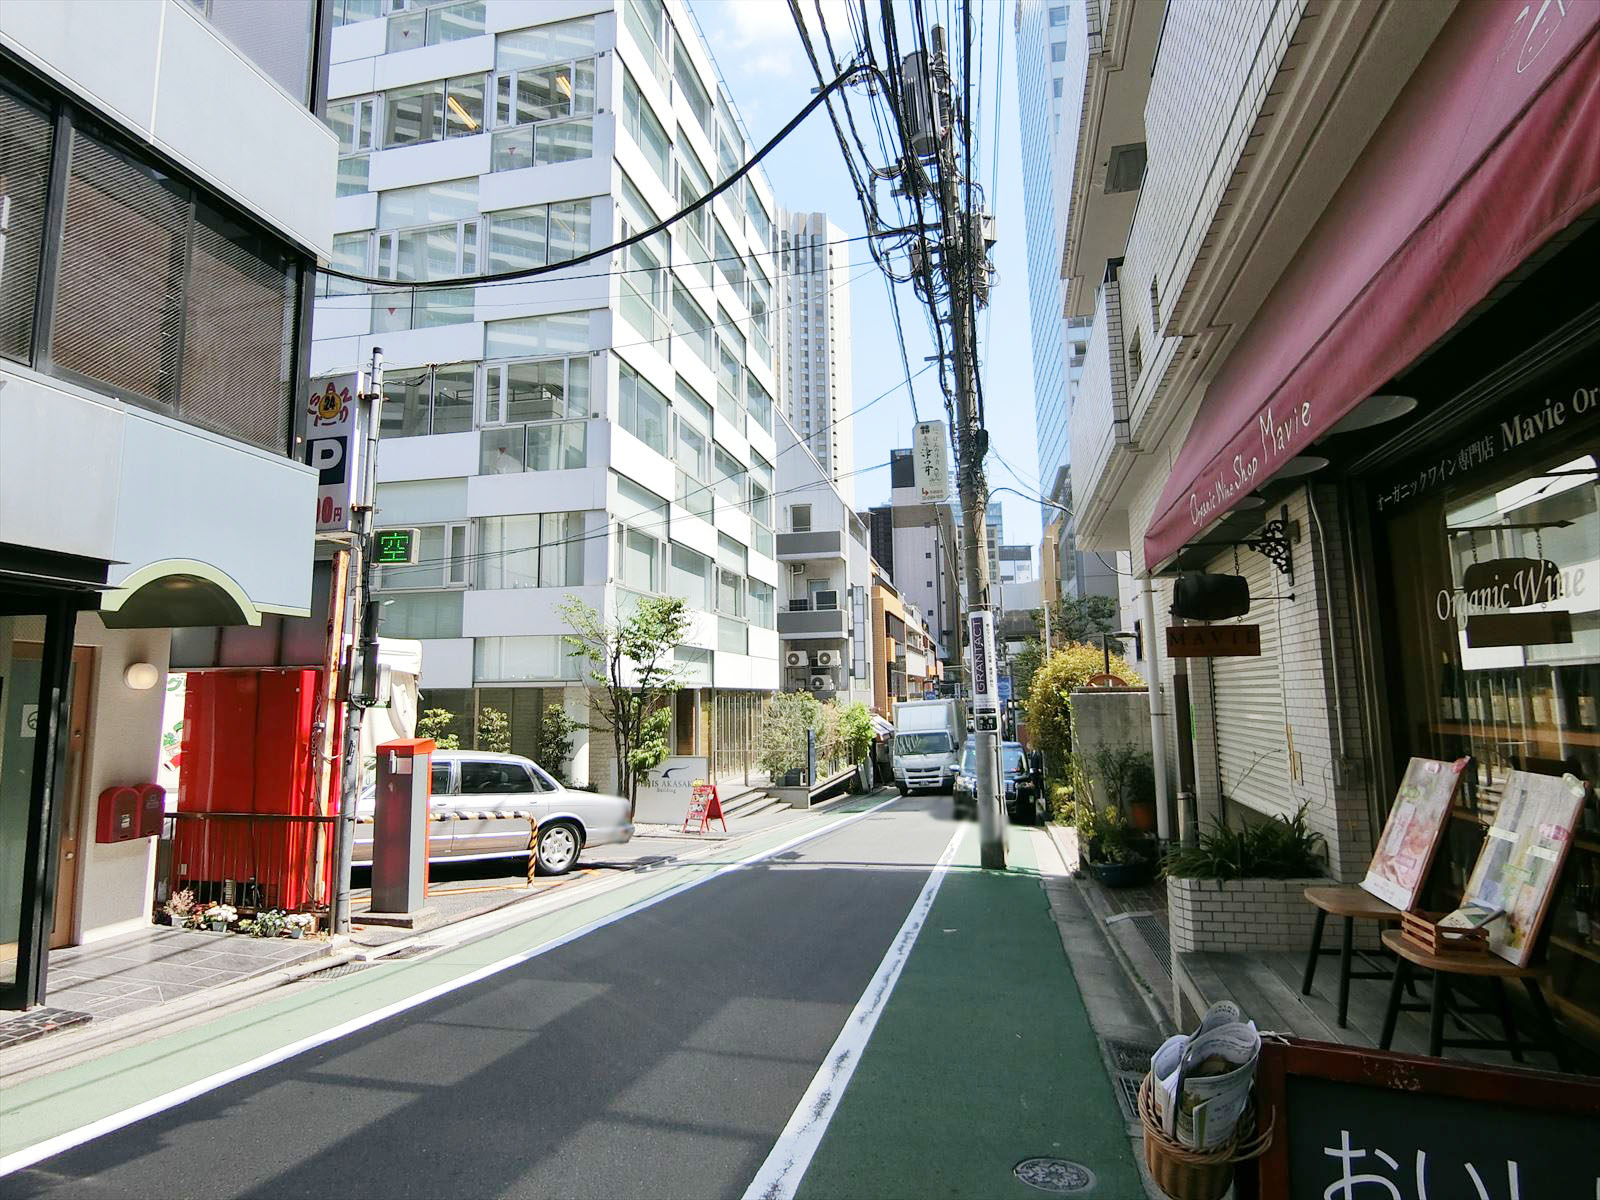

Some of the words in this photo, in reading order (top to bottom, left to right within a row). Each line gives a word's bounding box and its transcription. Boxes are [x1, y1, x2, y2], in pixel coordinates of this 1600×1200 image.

[1501, 397, 1567, 452] Mavie
[1573, 387, 1600, 413] Or
[311, 438, 344, 470] P
[1215, 471, 1234, 504] Wine
[1233, 454, 1258, 489] Shop
[1259, 402, 1312, 465] Mavie
[317, 496, 342, 524] 0円
[380, 532, 409, 562] 空
[1436, 574, 1510, 631] Organic
[1513, 558, 1586, 606] Wine
